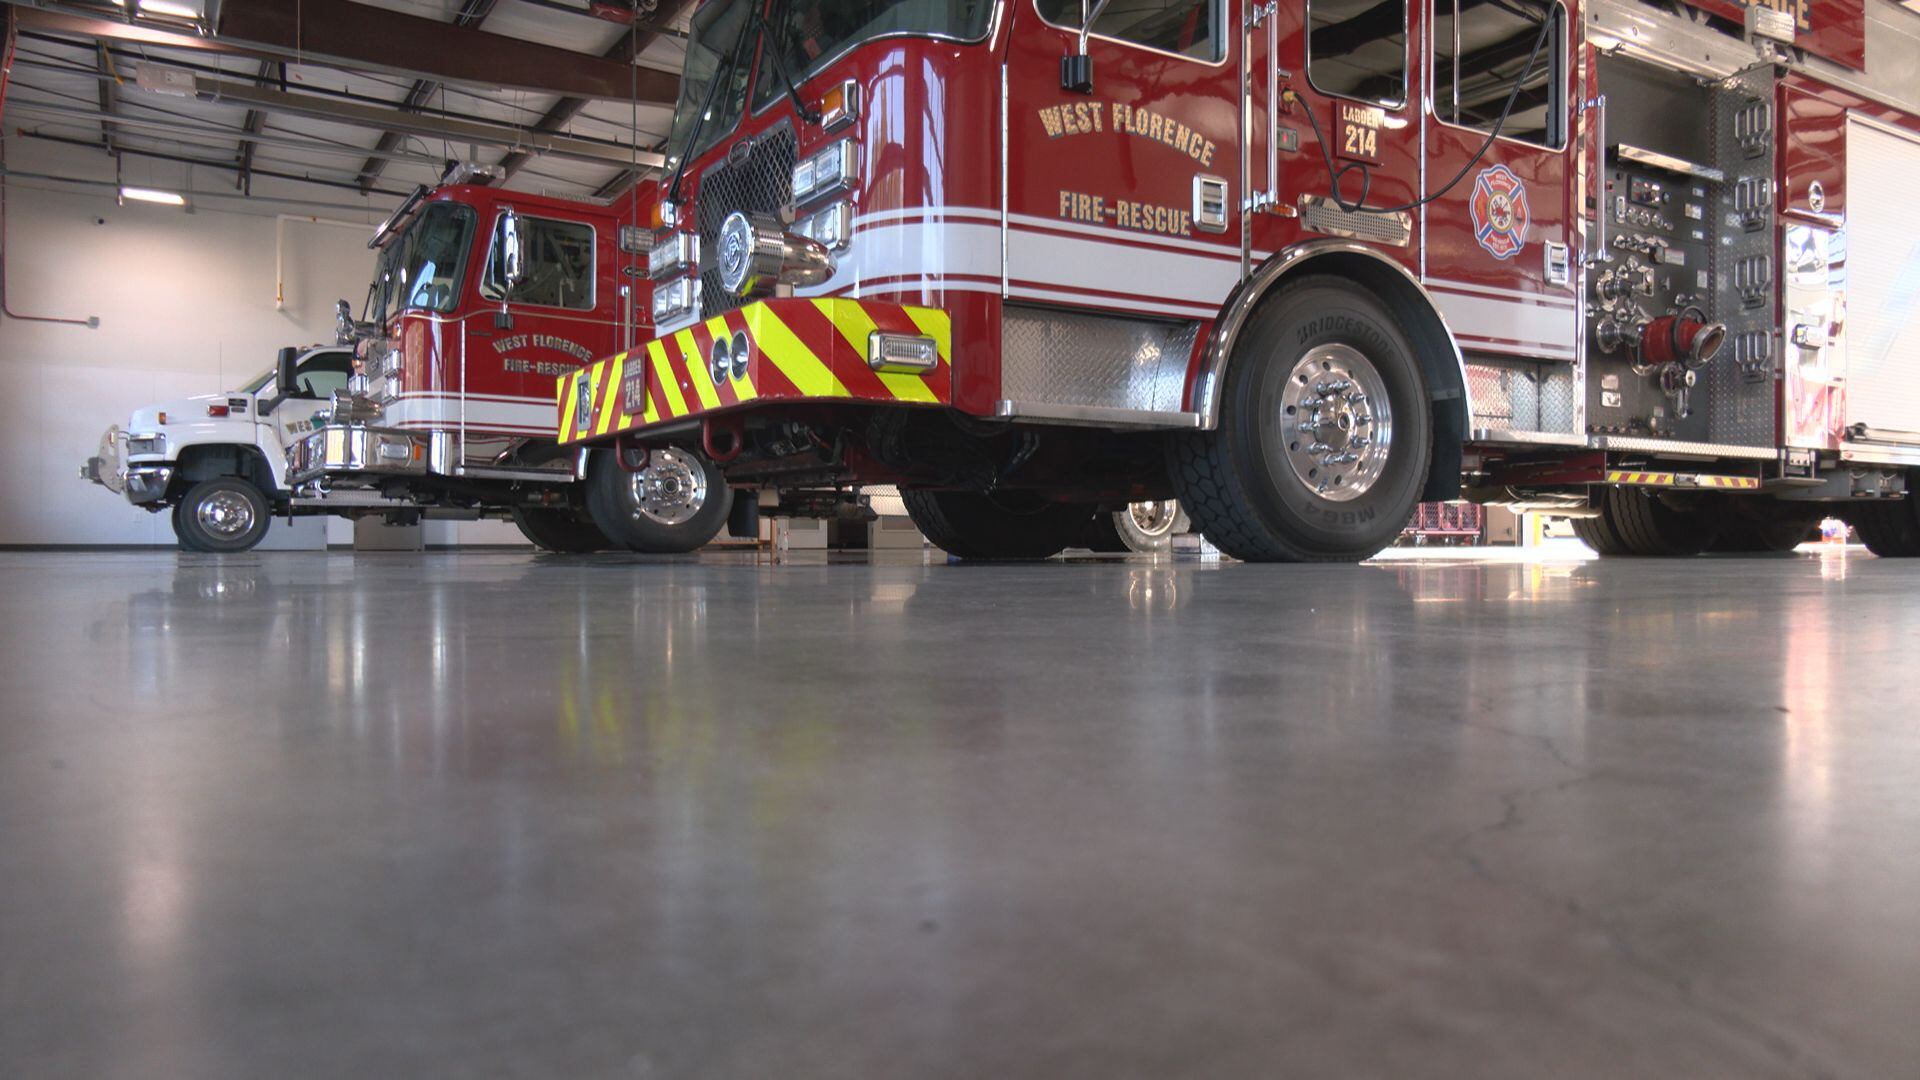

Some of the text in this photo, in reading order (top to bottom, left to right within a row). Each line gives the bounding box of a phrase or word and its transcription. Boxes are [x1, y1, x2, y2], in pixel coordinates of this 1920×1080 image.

[1343, 104, 1379, 129] LADDER
[1038, 102, 1215, 167] WEST FLORENCE
[1345, 124, 1376, 157] 214
[1059, 190, 1191, 236] FIRE-RESCUE
[492, 334, 593, 362] WEST FLORENCE
[1297, 315, 1395, 361] BRIDGESTONE
[625, 379, 640, 409] 214
